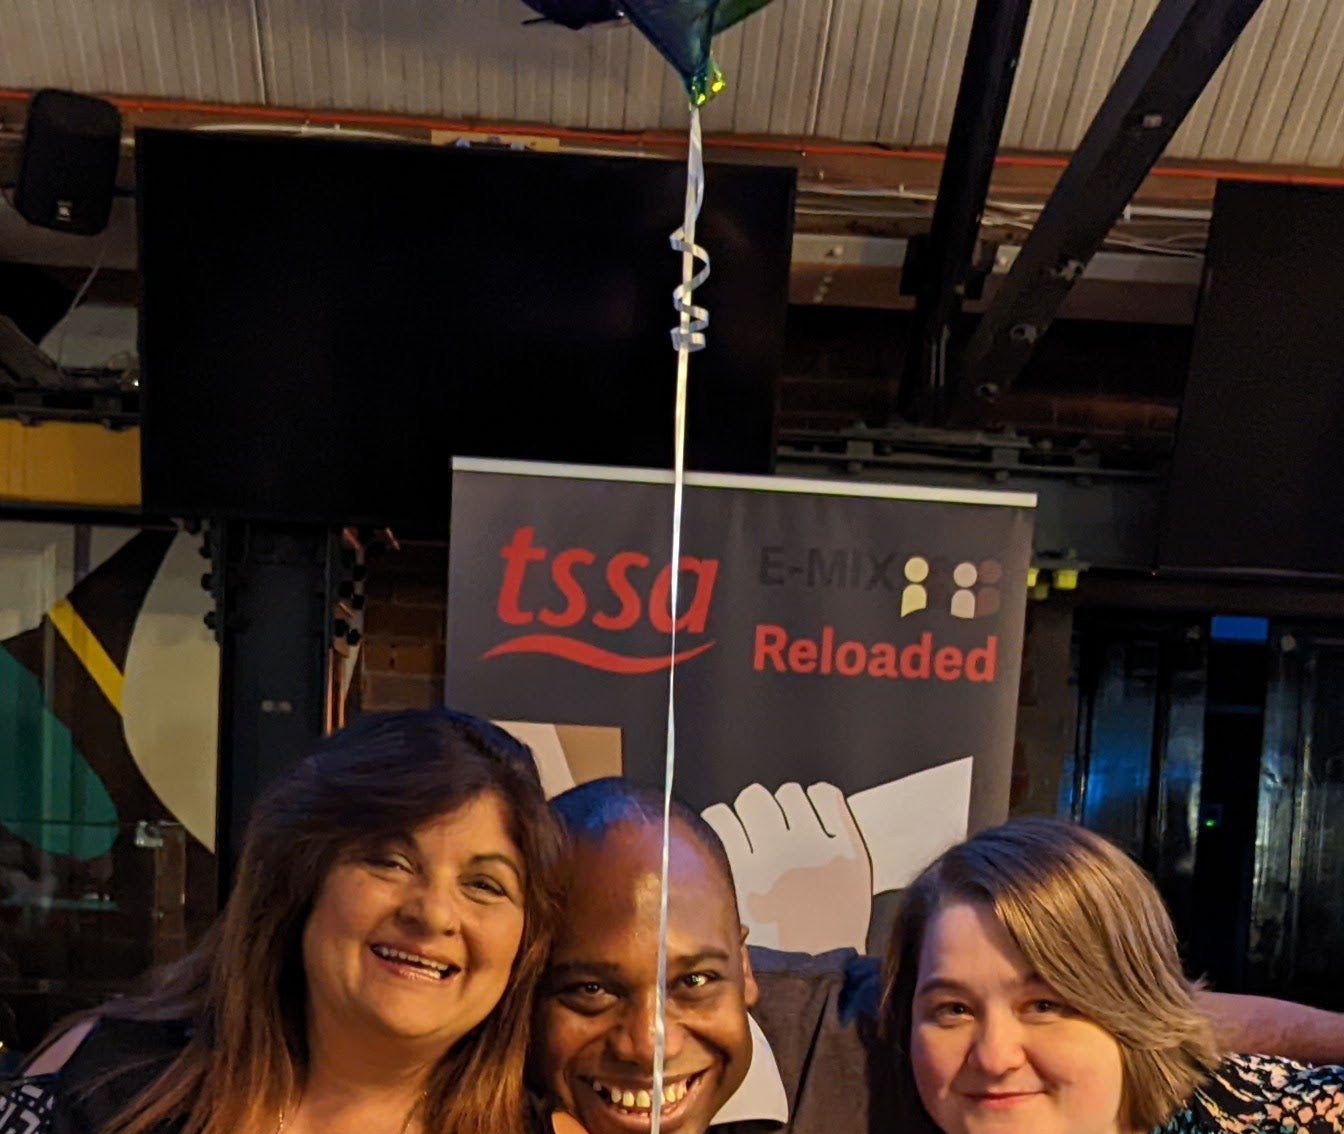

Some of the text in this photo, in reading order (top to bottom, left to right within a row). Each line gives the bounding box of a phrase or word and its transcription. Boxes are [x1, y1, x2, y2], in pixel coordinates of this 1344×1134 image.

[496, 526, 719, 634] tssa
[759, 545, 899, 594] E-MIX
[752, 624, 999, 683] Reloaded
